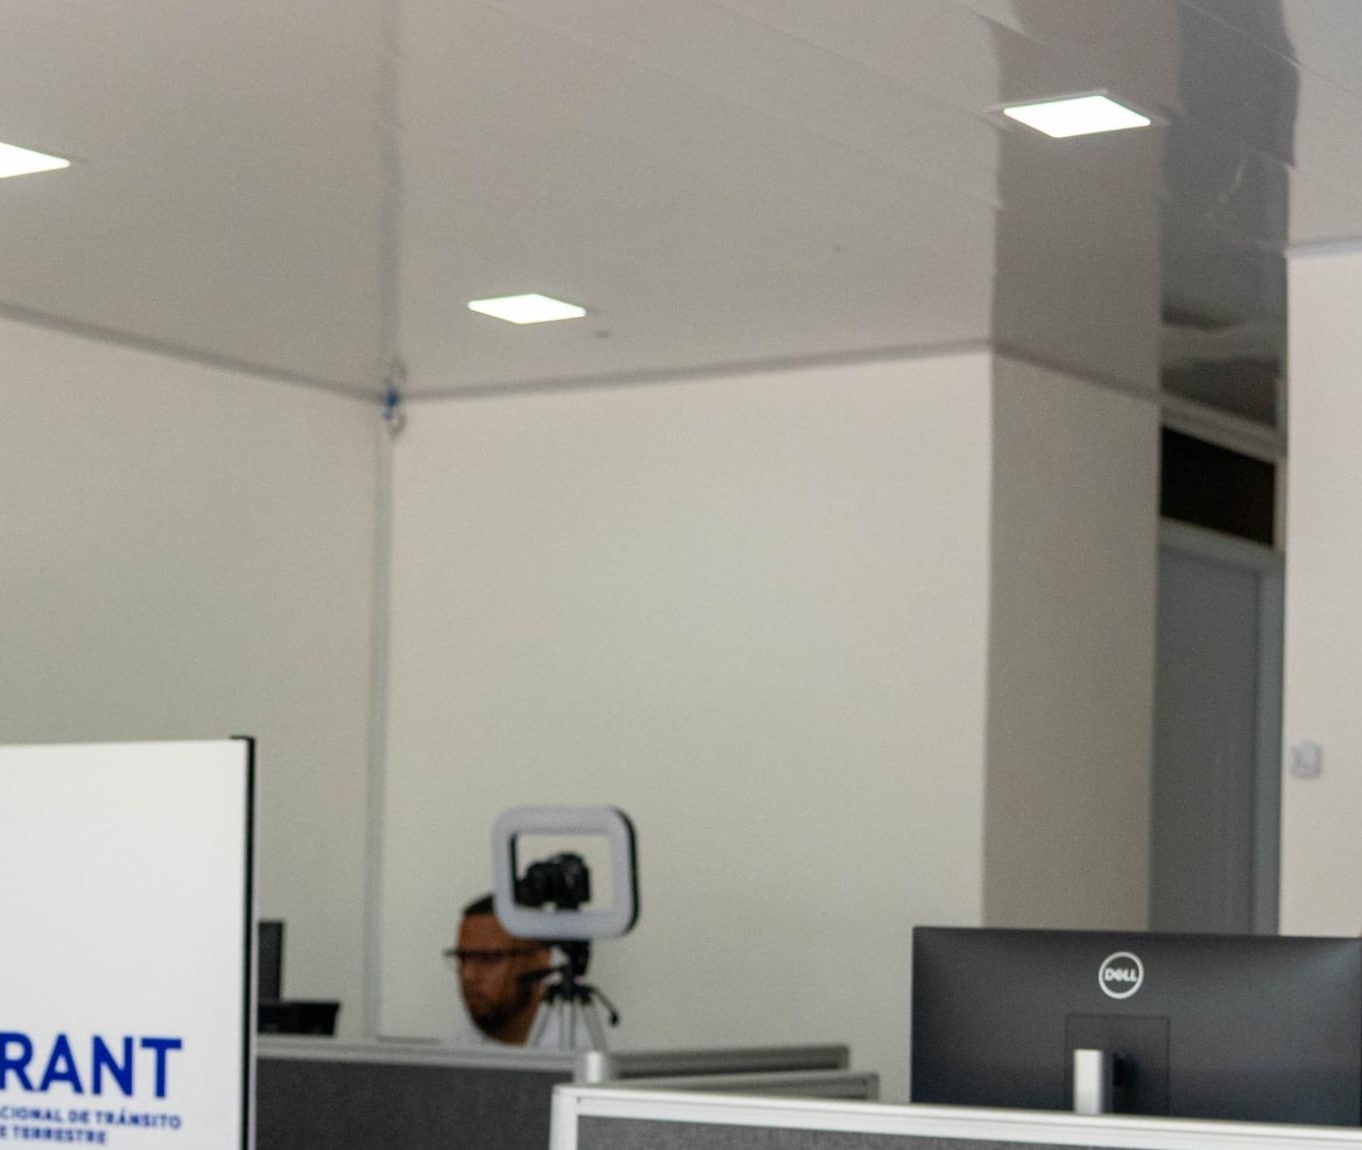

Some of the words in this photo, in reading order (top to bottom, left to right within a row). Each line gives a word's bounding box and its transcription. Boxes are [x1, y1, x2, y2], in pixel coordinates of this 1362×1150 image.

[1104, 967, 1138, 982] DELL
[68, 1109, 89, 1124] DE
[95, 1107, 182, 1130] TRÁNSITO
[11, 1125, 107, 1144] TERRESTRE
